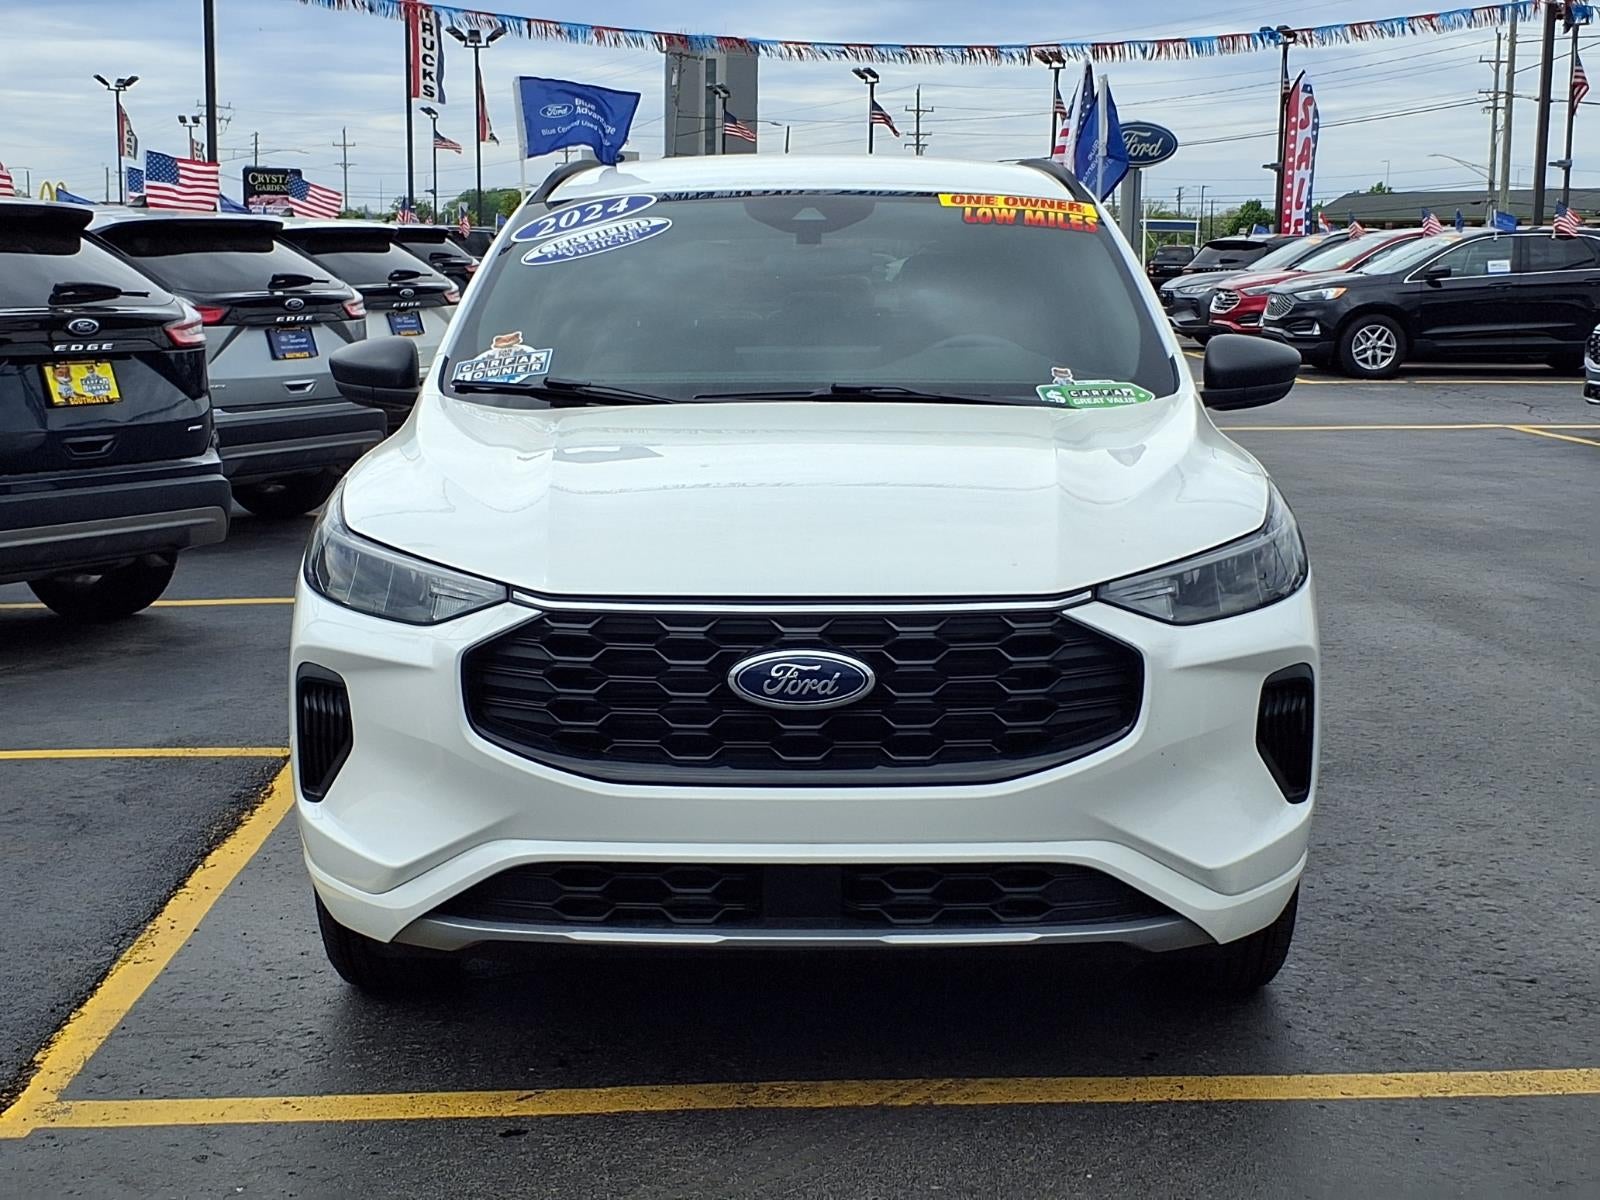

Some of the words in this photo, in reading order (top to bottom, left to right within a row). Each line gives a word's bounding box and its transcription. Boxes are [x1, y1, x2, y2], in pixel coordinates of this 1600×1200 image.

[574, 97, 596, 110] Blue
[1122, 130, 1164, 157] Ford
[1293, 96, 1314, 236] SALE
[248, 172, 290, 185] CRYSTA
[255, 184, 289, 192] GARDEN
[950, 194, 999, 205] ONE
[1003, 196, 1084, 213] OWNER
[535, 196, 630, 238] 2024
[963, 206, 1017, 225] LOW
[1023, 208, 1098, 233] MILES
[538, 219, 652, 255] CERTIFIED
[53, 343, 114, 352] EDGE
[461, 353, 545, 373] CARFAX
[472, 363, 542, 380] OWNER
[1069, 388, 1135, 398] CARFAX
[1073, 397, 1105, 405] GREAT
[1106, 396, 1137, 404] VALUE
[762, 662, 842, 696] Ford
